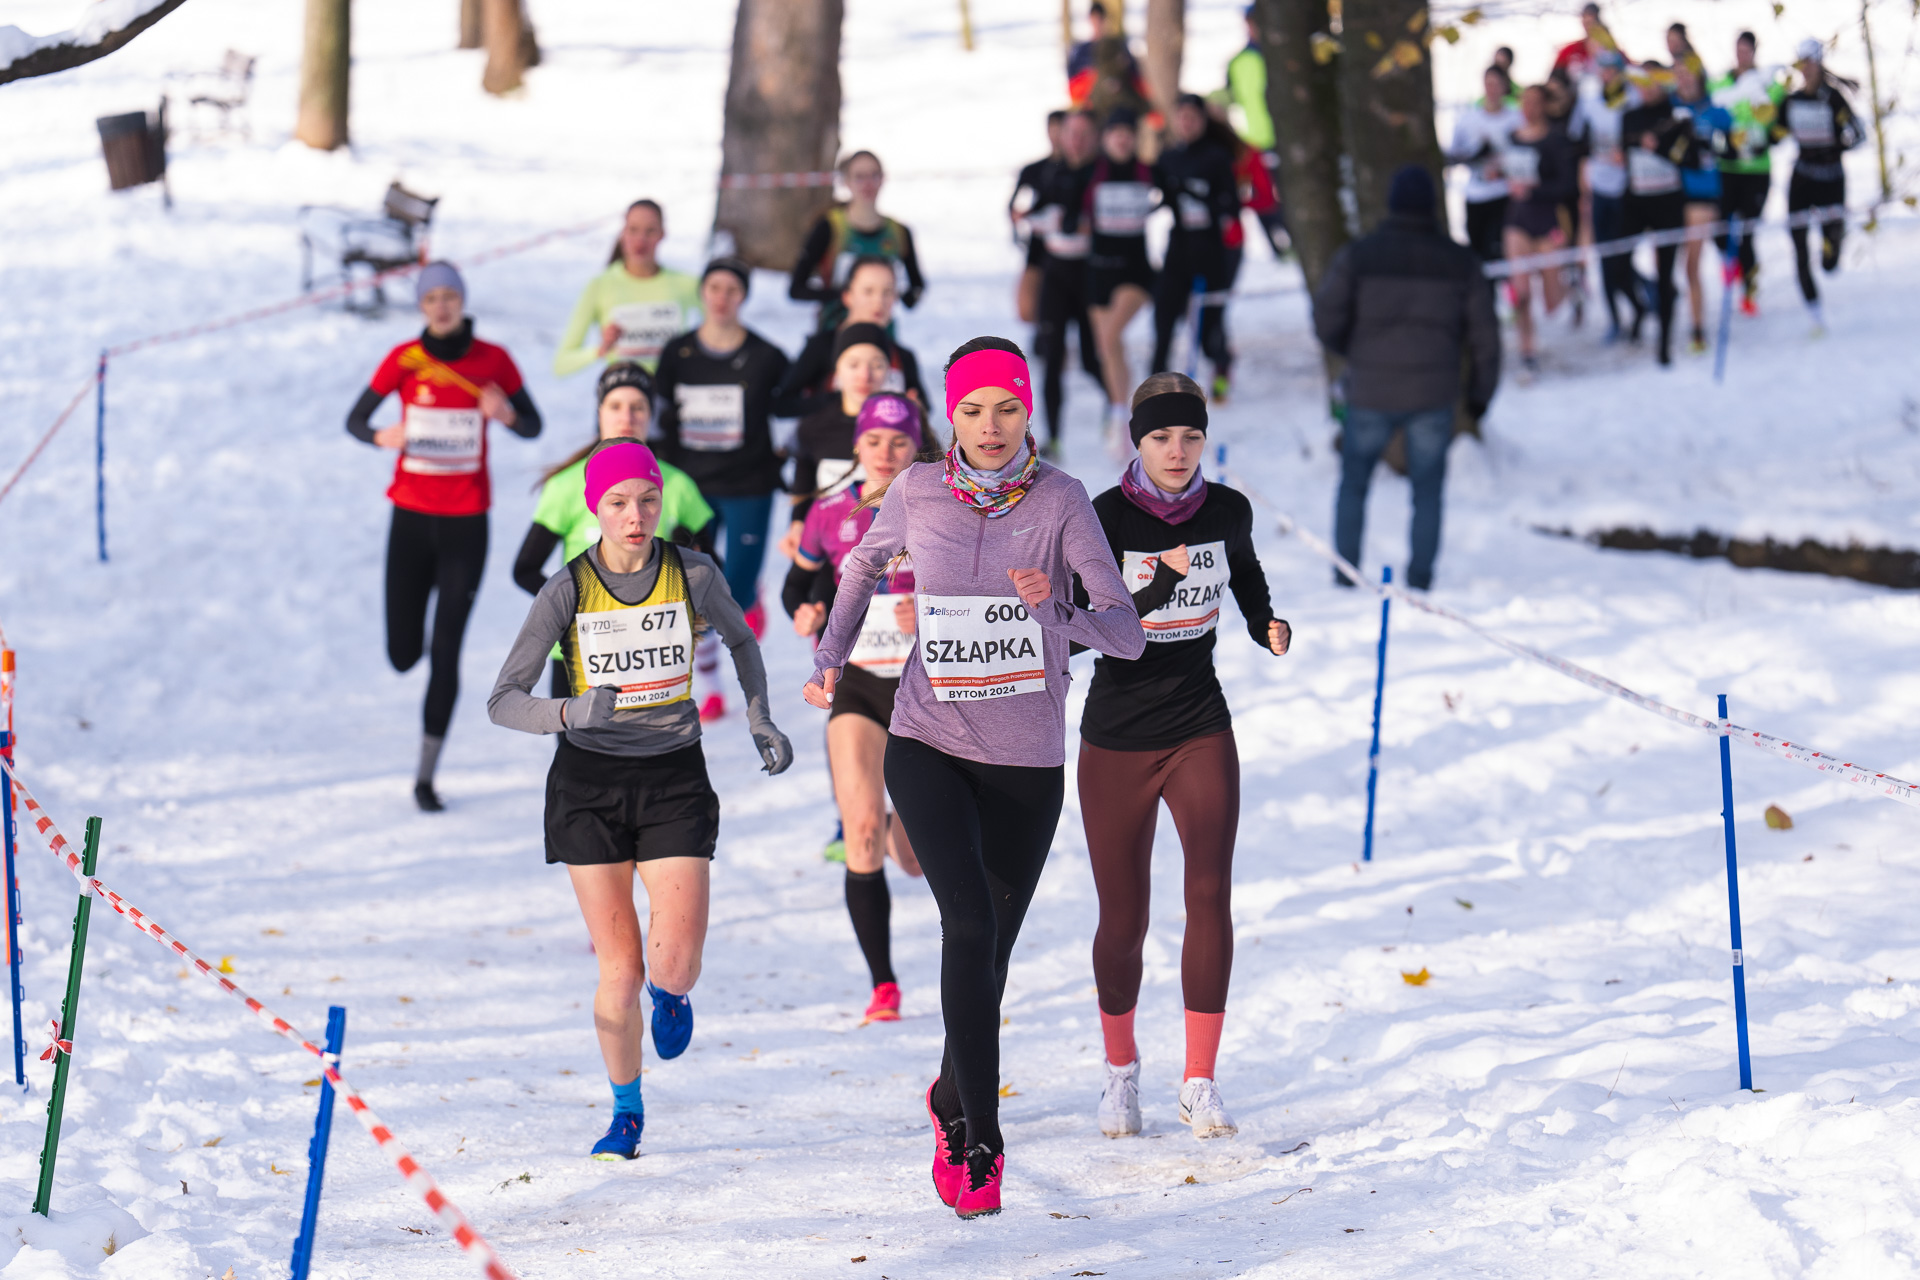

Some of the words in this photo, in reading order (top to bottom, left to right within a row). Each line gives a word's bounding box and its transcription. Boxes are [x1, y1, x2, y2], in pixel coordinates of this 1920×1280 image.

[1190, 550, 1214, 570] 48
[1157, 582, 1224, 611] PRZAK
[641, 610, 677, 631] 677
[928, 606, 971, 618] Bellsport
[984, 603, 1029, 624] 600
[592, 620, 611, 631] 770
[1146, 631, 1180, 640] BYTOM
[1183, 627, 1204, 637] 2024
[588, 645, 685, 674] SZUSTER
[926, 637, 1037, 664] SZŁAPKA
[615, 694, 647, 704] YTOM
[649, 690, 670, 700] 2024
[948, 690, 987, 699] BYTOM
[990, 685, 1016, 696] 2024
